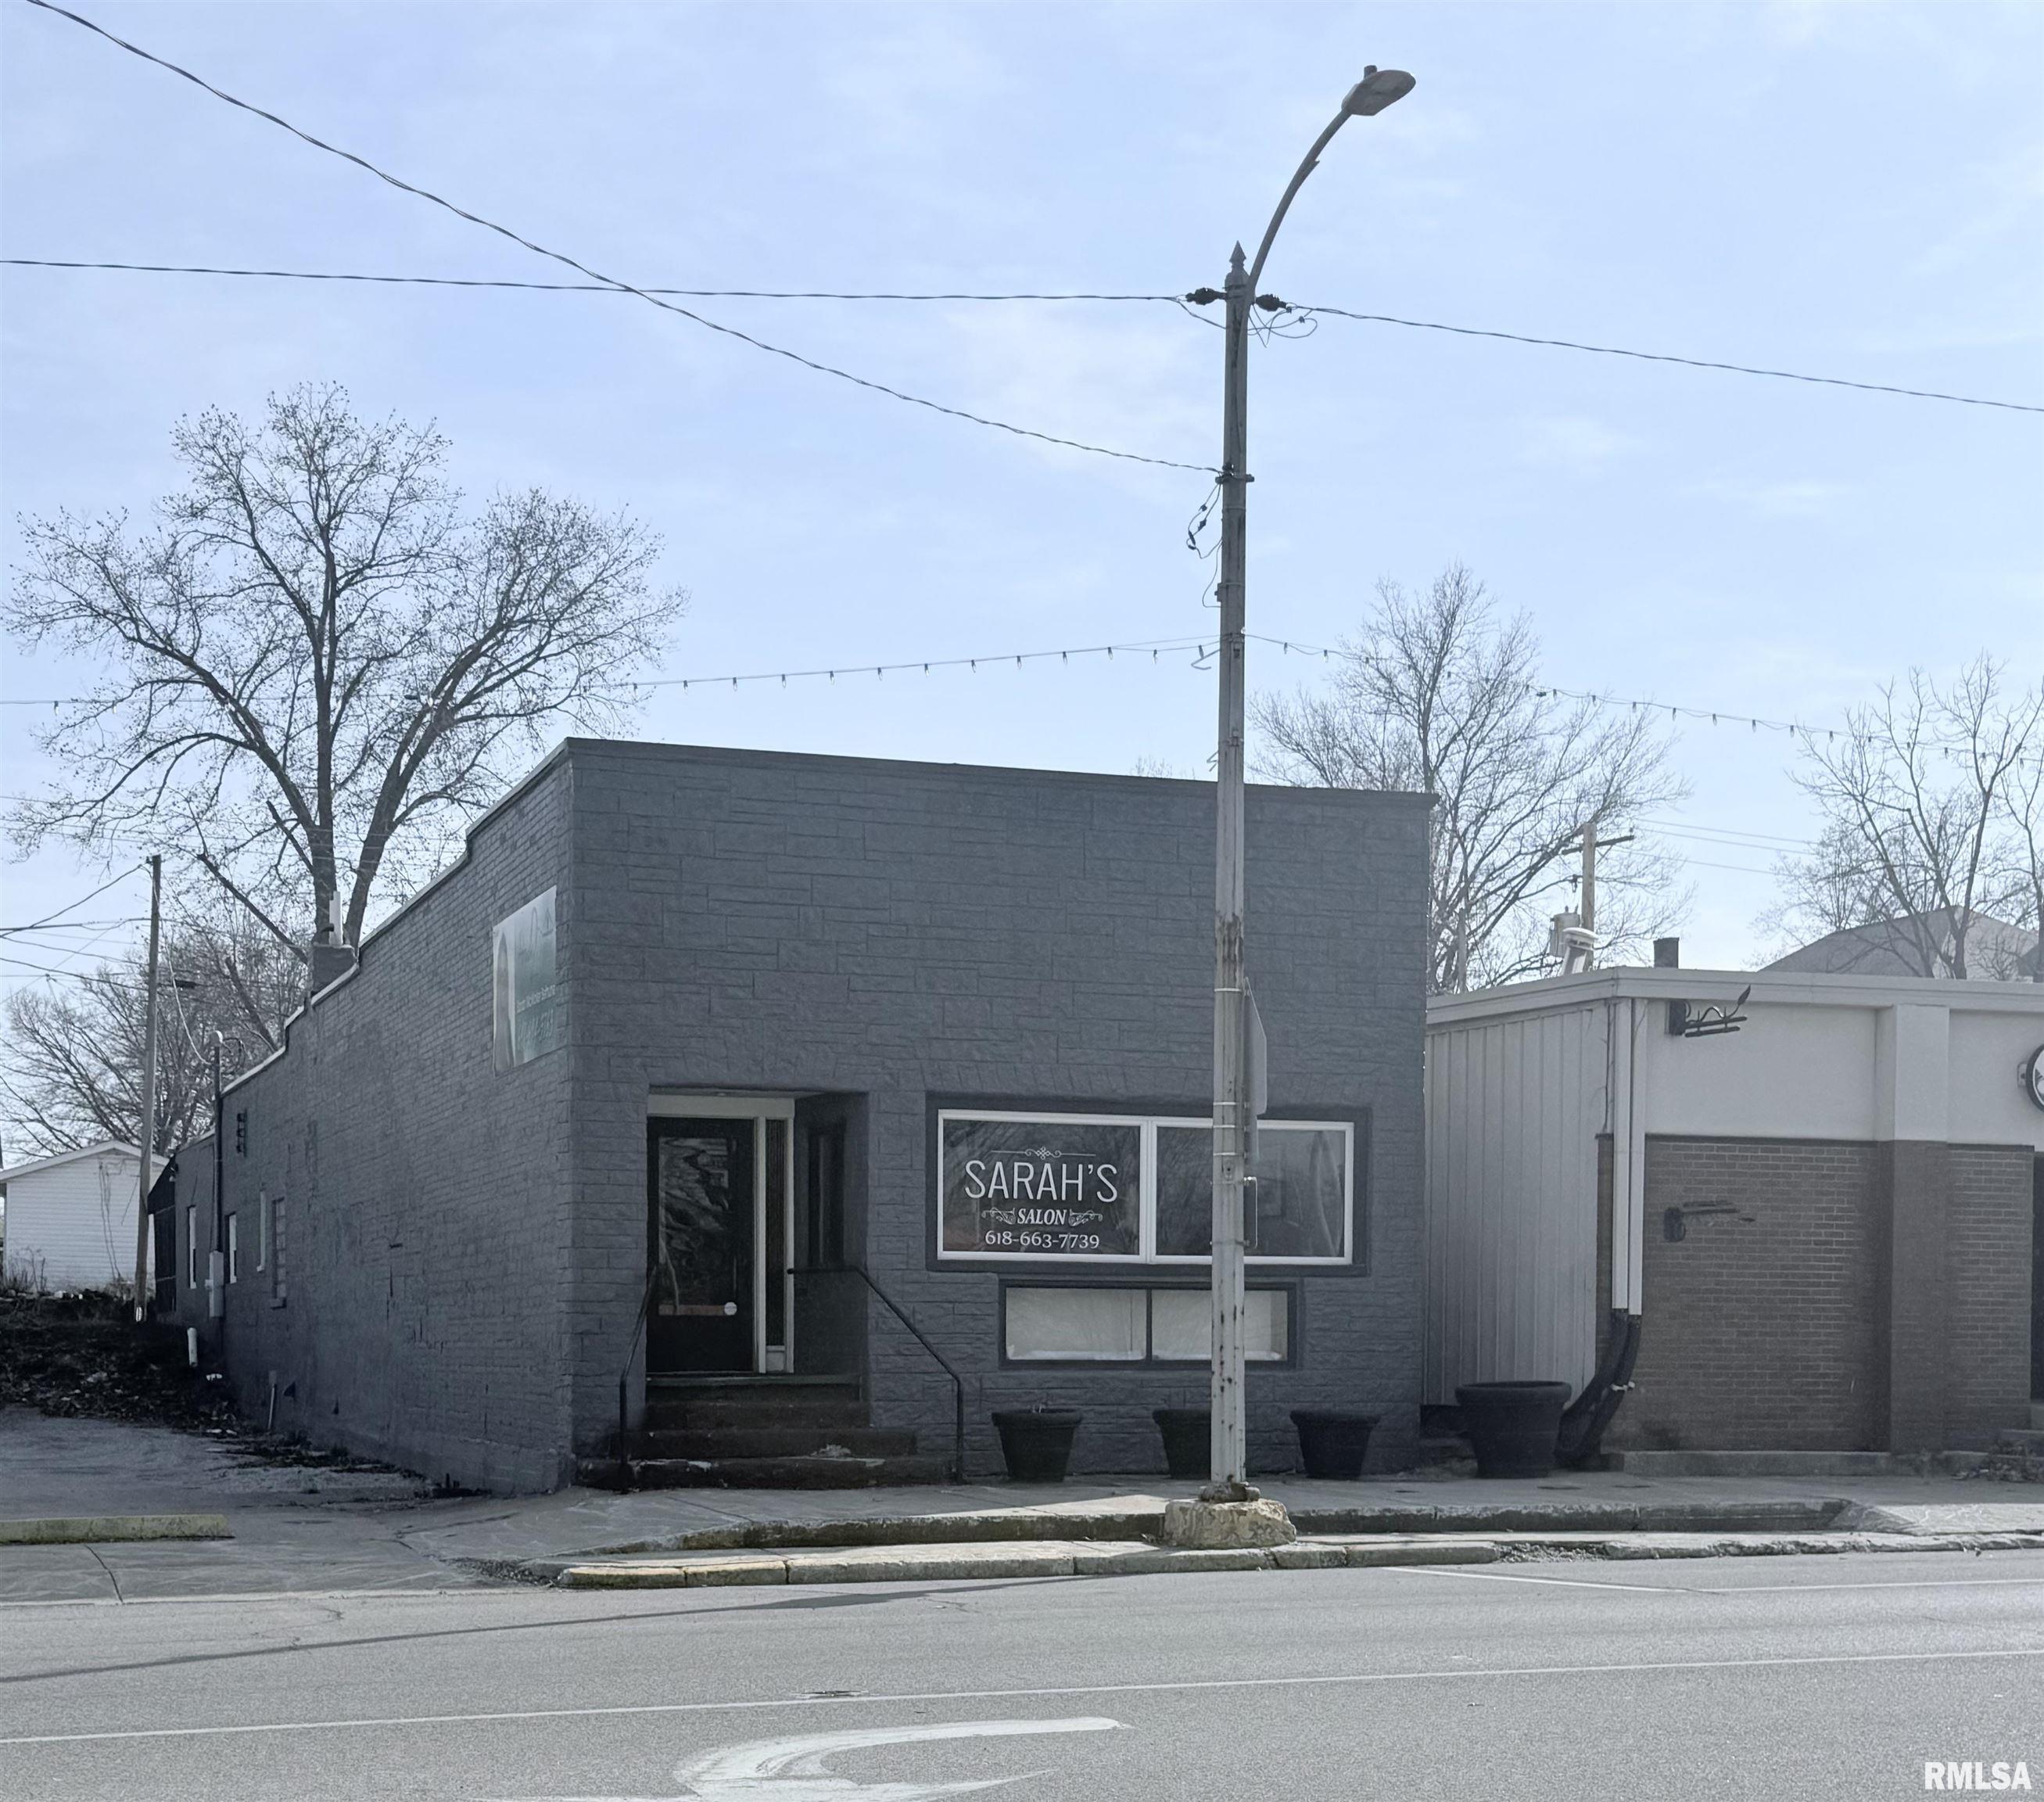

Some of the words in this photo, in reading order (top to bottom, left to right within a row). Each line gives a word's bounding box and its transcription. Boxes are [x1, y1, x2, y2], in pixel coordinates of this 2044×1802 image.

[965, 1160, 1118, 1203] SARAH'S
[1017, 1208, 1067, 1226] SALON
[985, 1230, 1100, 1249] 618-663-7739
